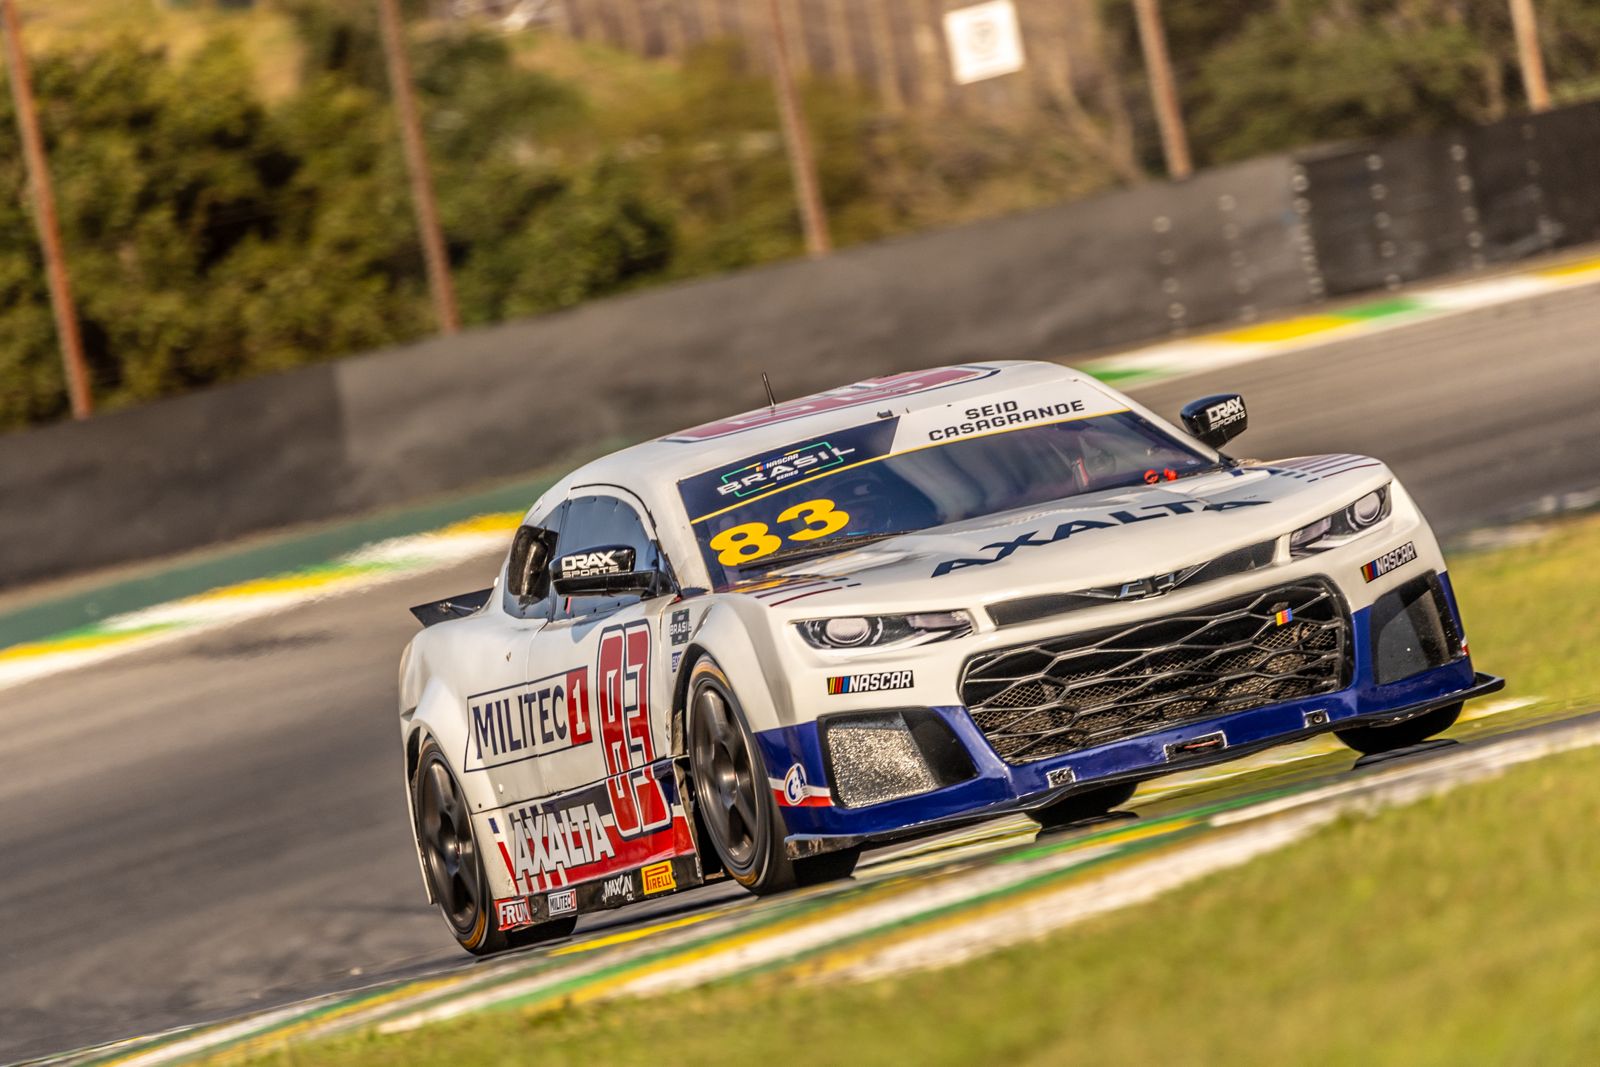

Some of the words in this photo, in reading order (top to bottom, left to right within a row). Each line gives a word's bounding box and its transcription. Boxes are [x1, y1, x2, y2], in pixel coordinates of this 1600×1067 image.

[929, 400, 1085, 441] CASAGRANDE
[965, 400, 1018, 420] SEID
[1210, 410, 1246, 431] SPORTS
[717, 447, 856, 495] BRASIL
[766, 453, 799, 469] NASCAR
[776, 470, 799, 480] SERIES
[709, 498, 850, 566] 83
[931, 500, 1273, 578] AXALTA
[562, 565, 619, 579] SPORTS
[1375, 542, 1416, 576] NASCAR
[849, 671, 912, 692] NASCAR
[598, 622, 671, 840] 83
[514, 803, 616, 880] AXALTA
[645, 864, 673, 891] PIRELLI
